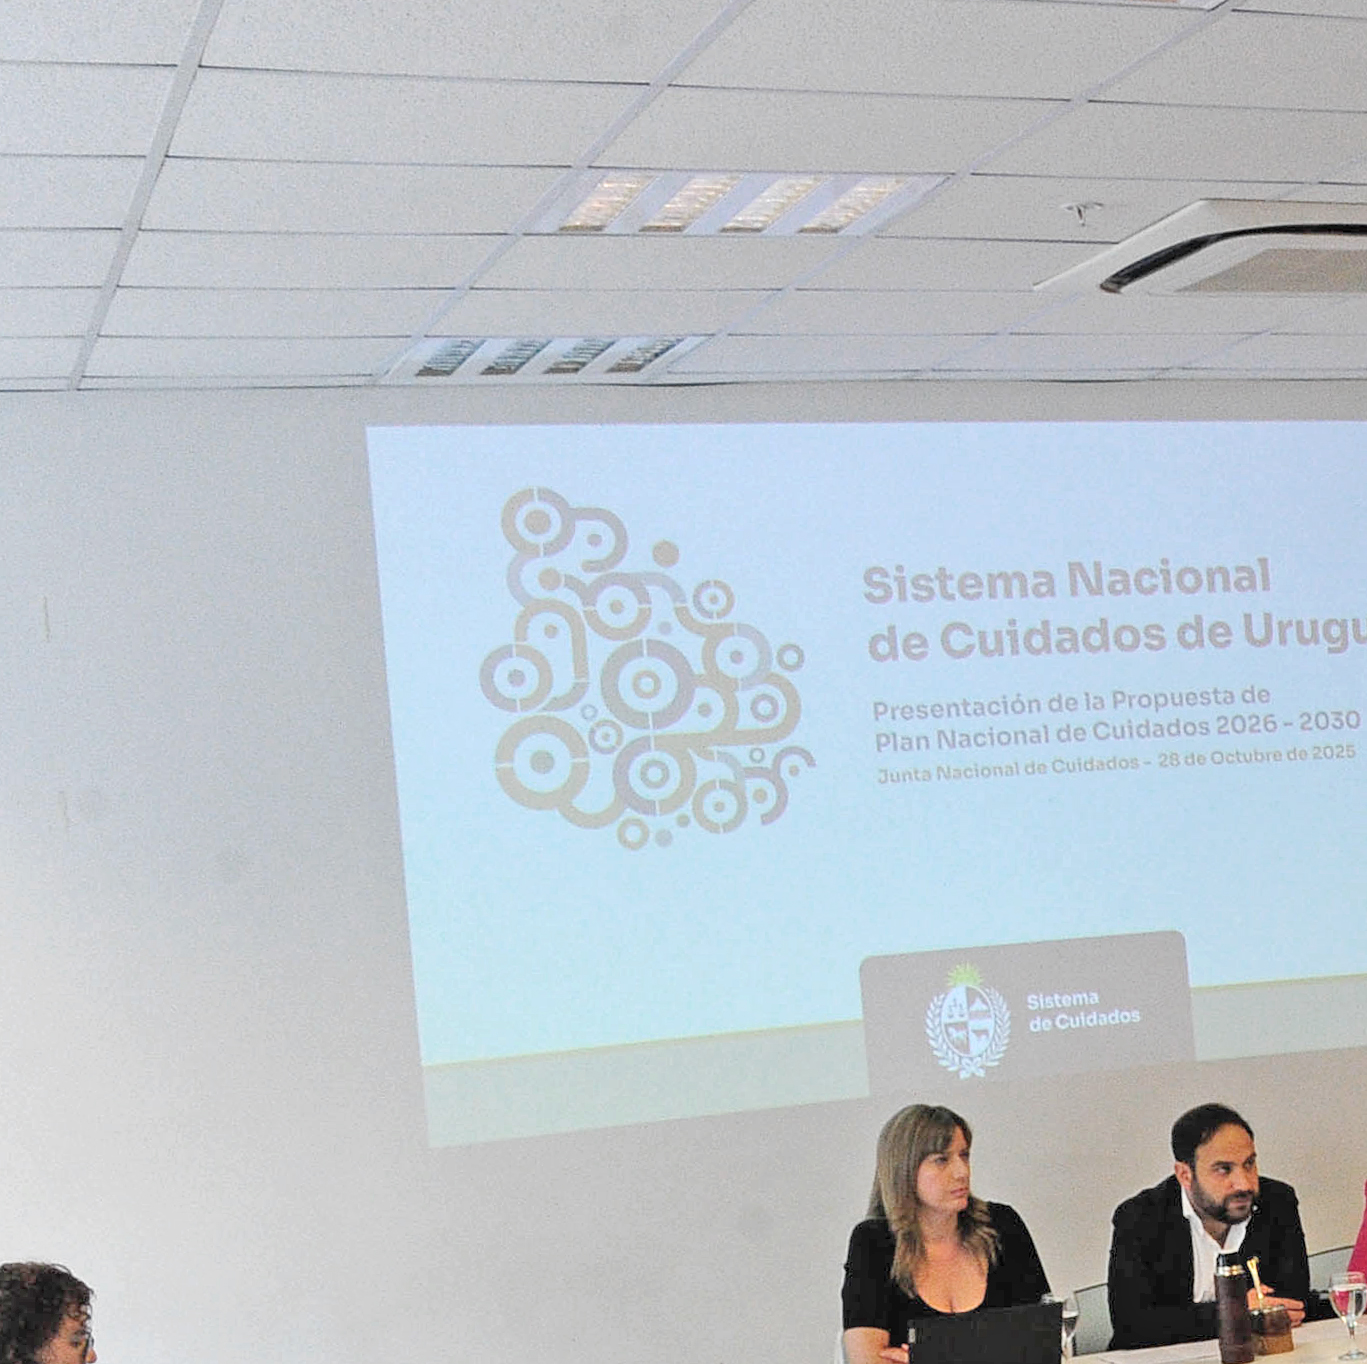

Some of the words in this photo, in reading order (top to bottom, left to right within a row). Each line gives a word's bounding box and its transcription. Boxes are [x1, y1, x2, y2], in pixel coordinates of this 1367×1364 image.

[863, 564, 1056, 604] Sistema
[1067, 557, 1271, 598] Nacional
[867, 624, 930, 662] de
[940, 618, 1167, 659] Cuidados
[1176, 614, 1233, 650] de
[872, 693, 1042, 721] Presentación
[1046, 691, 1079, 714] de
[1083, 690, 1106, 712] la
[1111, 687, 1236, 714] Propuesta
[1240, 685, 1271, 705] de
[875, 731, 931, 753] Plan
[936, 725, 1050, 750] Nacional
[1055, 723, 1088, 743] de
[1092, 716, 1211, 742] Cuidados
[1216, 713, 1279, 735] 2026
[1299, 710, 1362, 731] 2030
[877, 766, 932, 785] Junta
[936, 760, 1020, 781] Nacional
[1024, 759, 1049, 776] de
[1051, 753, 1141, 774] Cuidados
[1158, 751, 1181, 768] 28
[1183, 749, 1207, 766] de
[1210, 746, 1283, 765] Octubre
[1286, 745, 1309, 762] de
[1312, 743, 1357, 760] 2025
[1026, 989, 1099, 1011] Sistema
[1029, 1016, 1051, 1032] de
[1055, 1008, 1142, 1030] Cuidados
